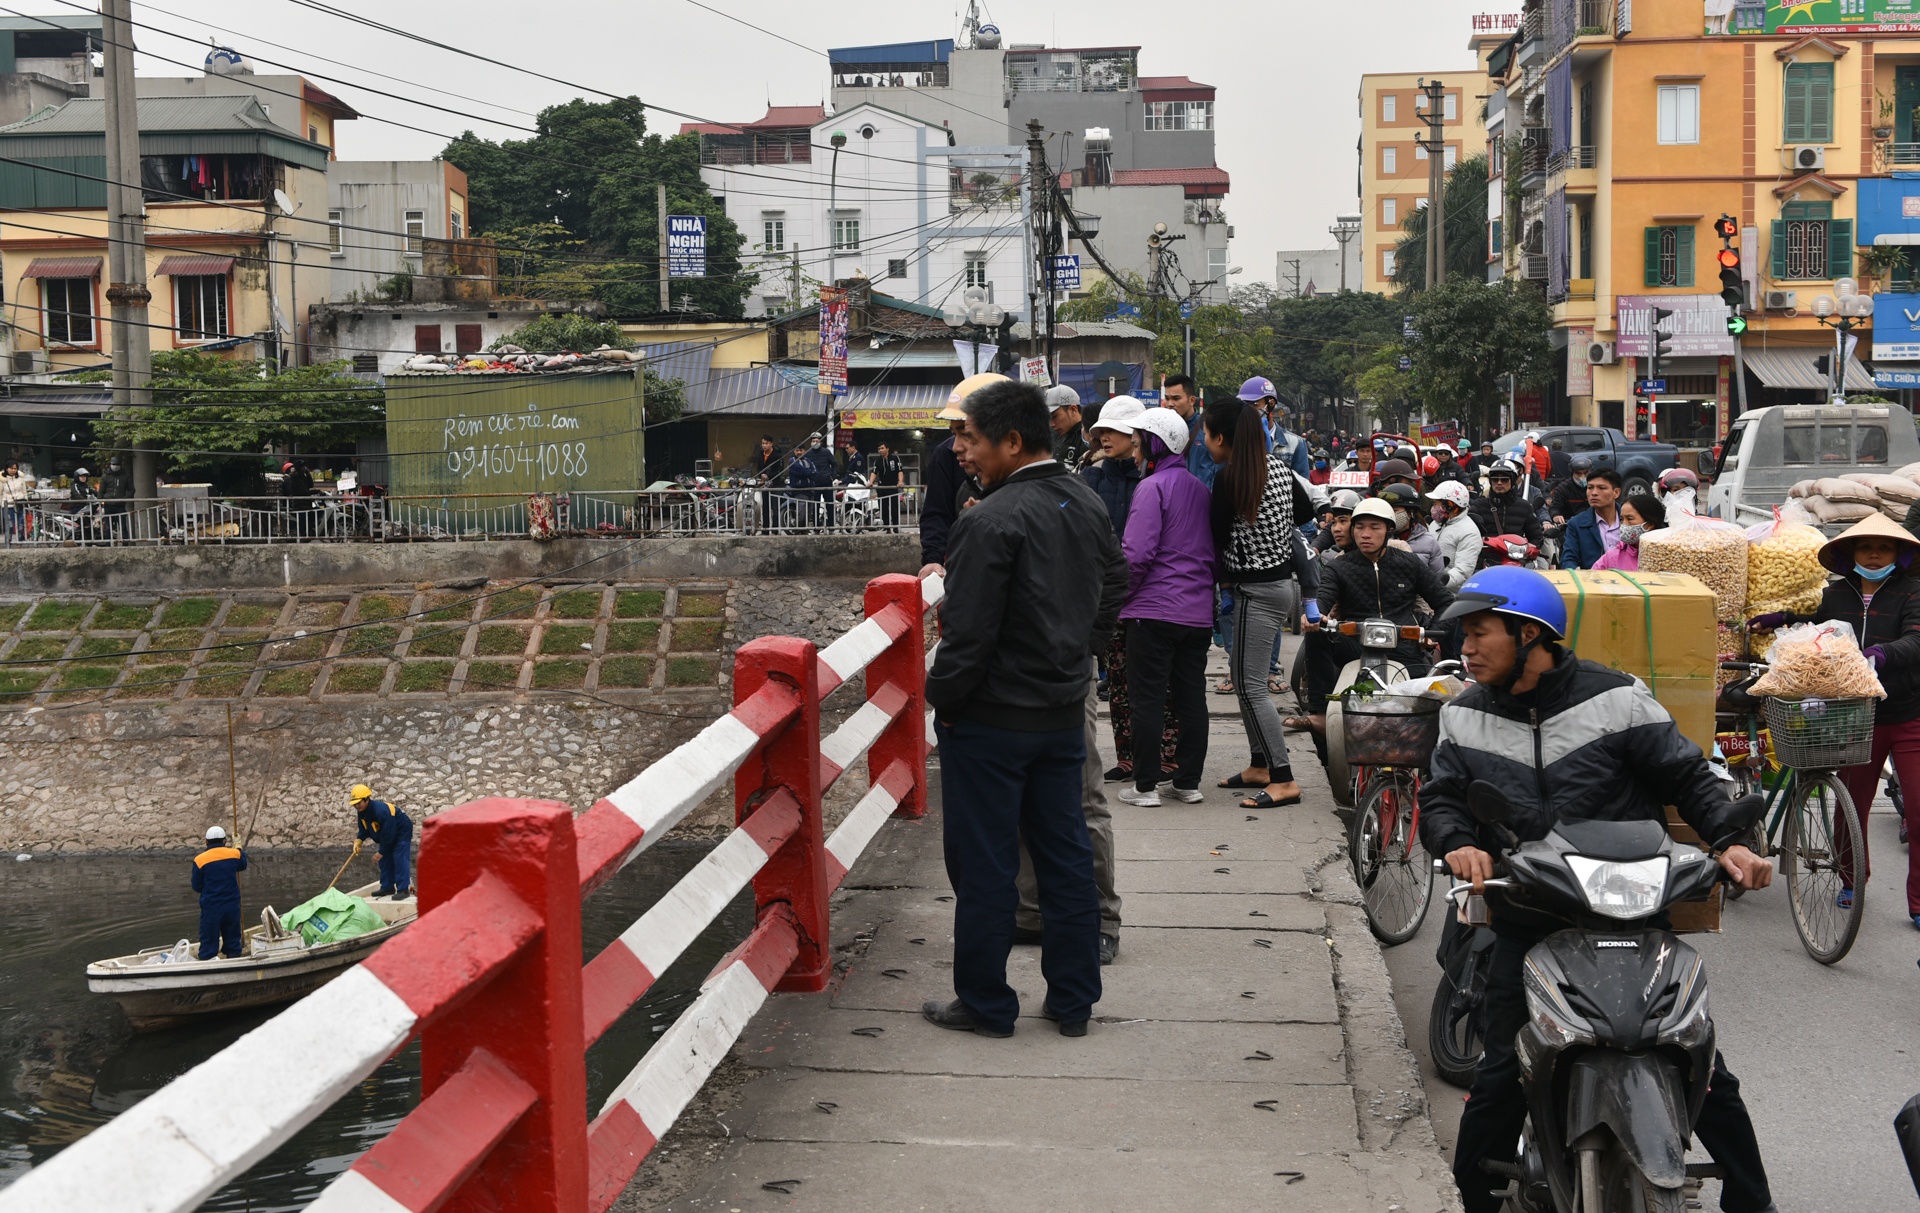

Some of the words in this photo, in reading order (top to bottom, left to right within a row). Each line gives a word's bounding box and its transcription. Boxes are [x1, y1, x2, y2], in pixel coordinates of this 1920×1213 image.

[1472, 12, 1491, 32] VIỆN
[1494, 15, 1500, 28] Y
[1502, 14, 1518, 31] HỌC
[672, 217, 703, 231] NHÀ
[669, 231, 705, 248] NGHỈ
[1570, 342, 1587, 359] VÀN
[899, 412, 911, 420] NEM
[912, 412, 928, 420] CHUA
[447, 441, 588, 481] 0916041088
[1731, 736, 1768, 750] Beaty
